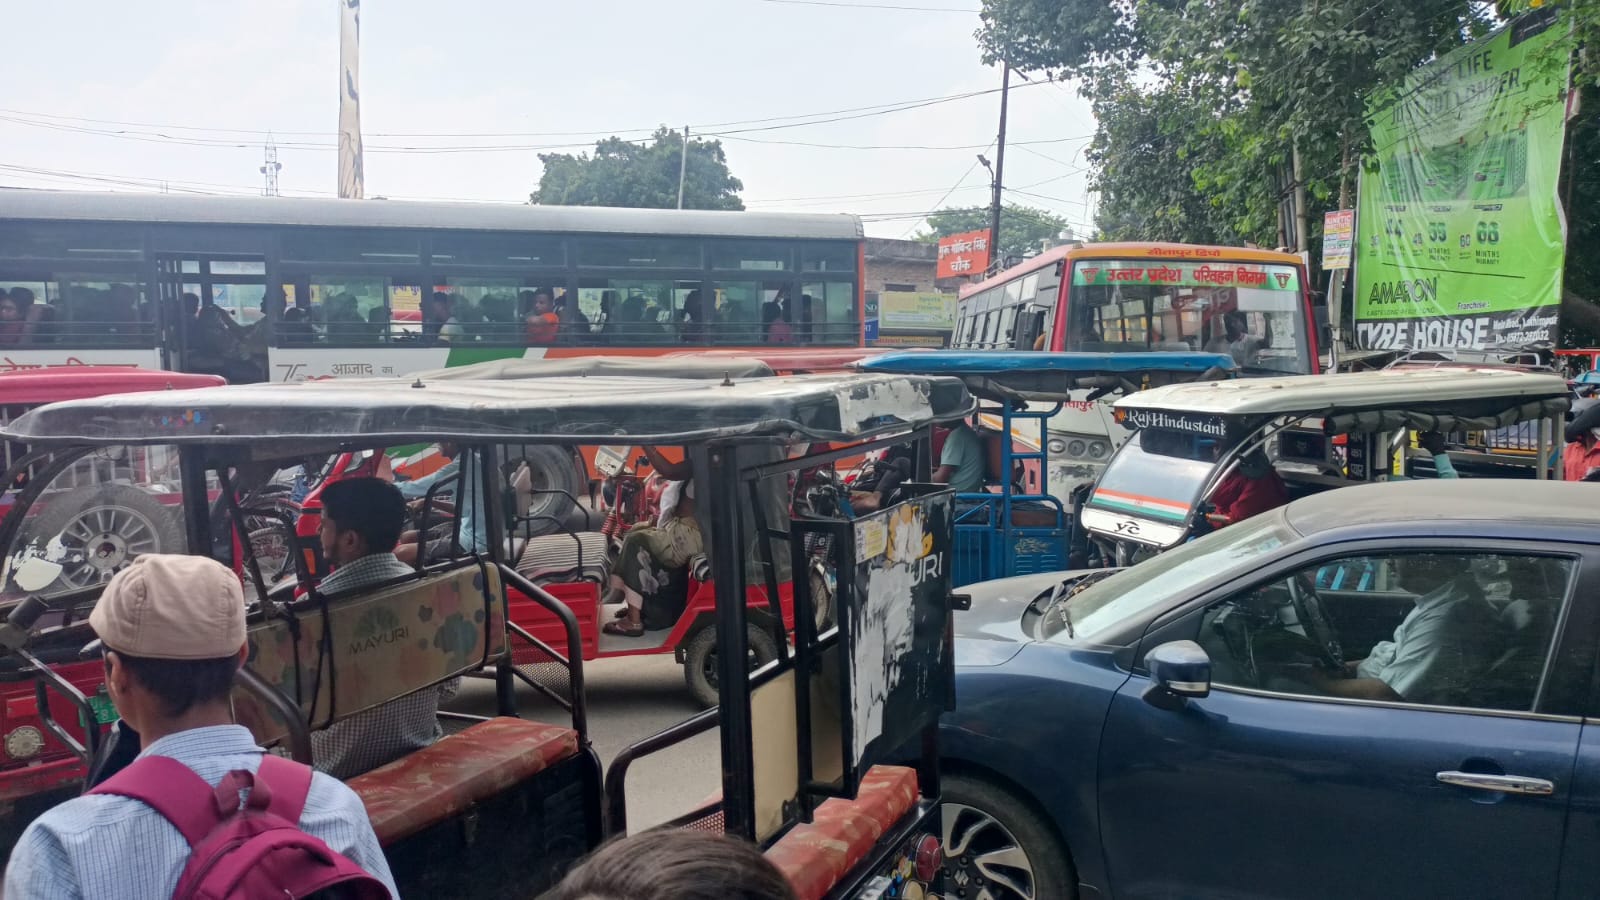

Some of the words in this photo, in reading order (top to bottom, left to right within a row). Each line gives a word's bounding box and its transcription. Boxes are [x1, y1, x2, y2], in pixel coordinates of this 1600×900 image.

[1458, 50, 1493, 80] LIFE
[951, 257, 971, 270] चौक
[1146, 265, 1182, 283] प्रदेश
[1193, 266, 1234, 284] परिवहन
[1236, 267, 1267, 285] निगम
[1368, 276, 1437, 305] AMARON
[1356, 321, 1409, 351] TYRE
[1413, 317, 1490, 352] HOUSE
[349, 626, 409, 656] MAYURI
